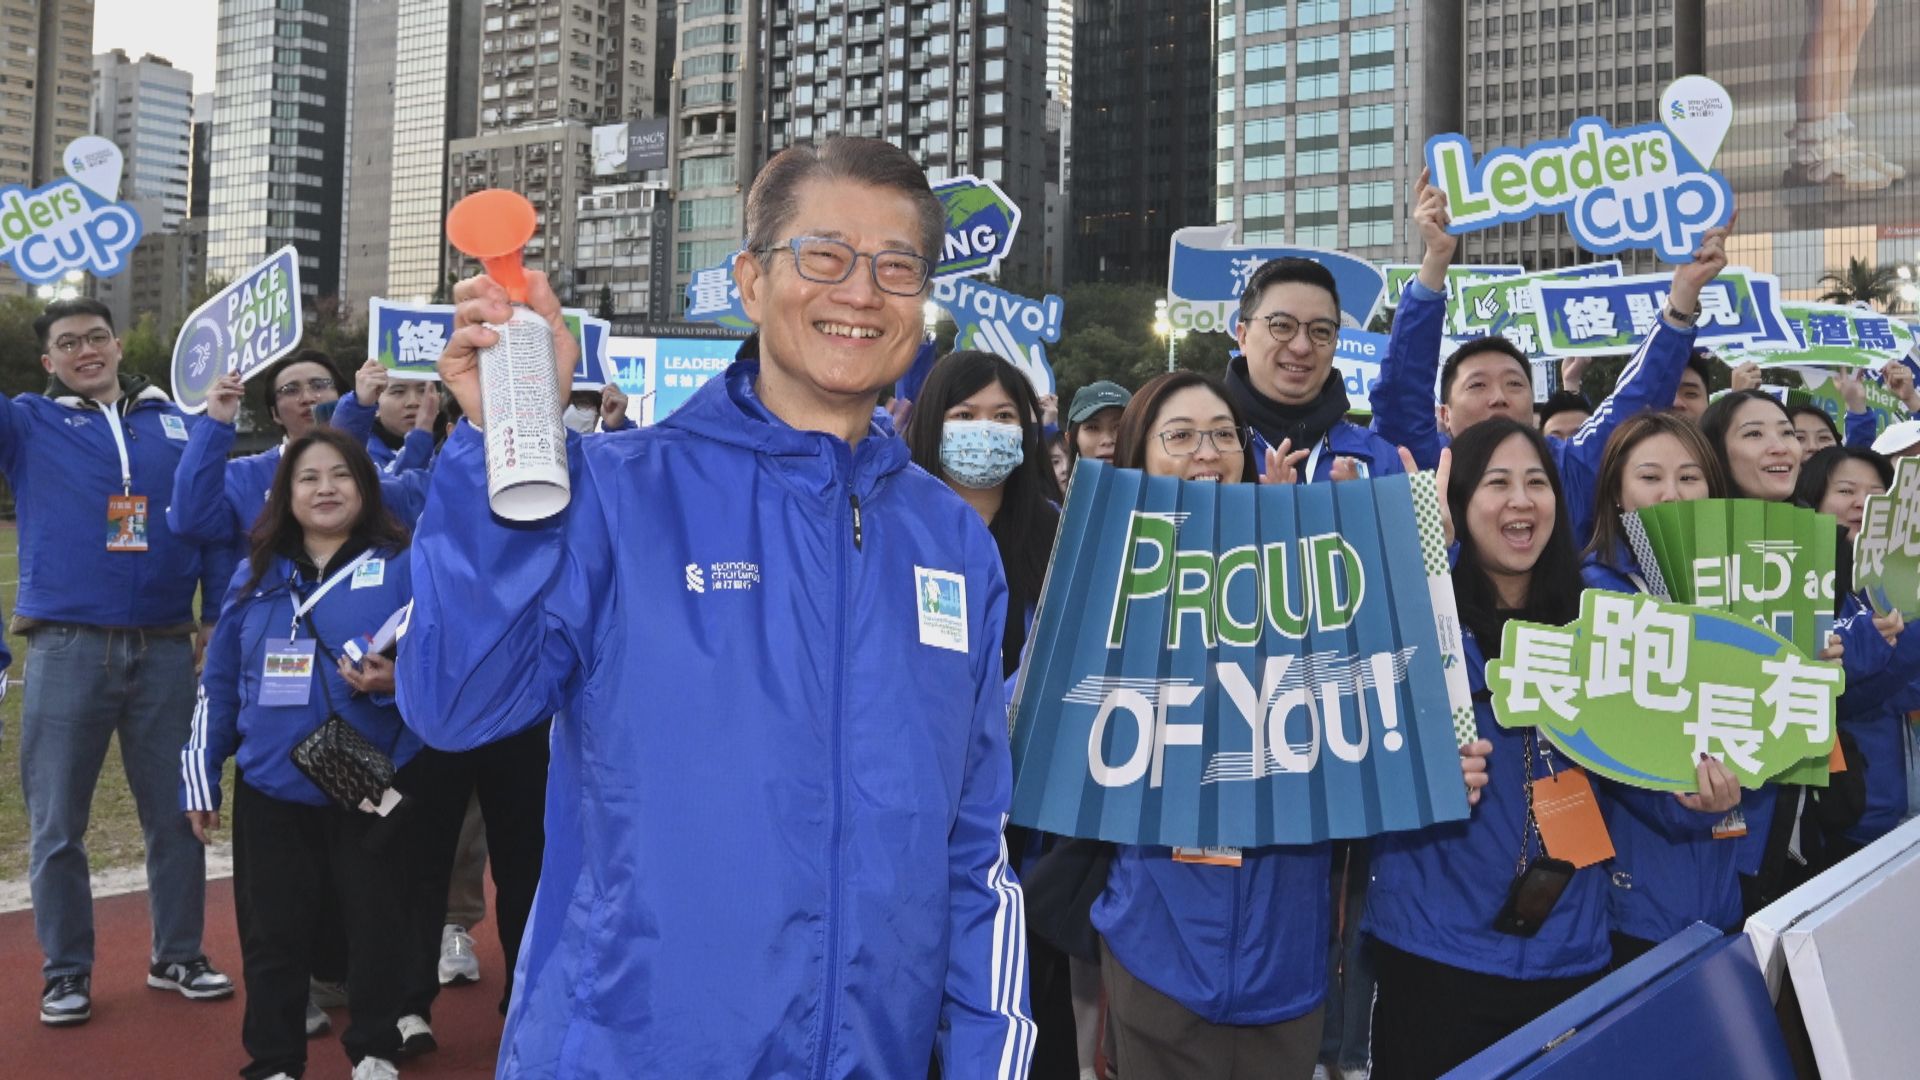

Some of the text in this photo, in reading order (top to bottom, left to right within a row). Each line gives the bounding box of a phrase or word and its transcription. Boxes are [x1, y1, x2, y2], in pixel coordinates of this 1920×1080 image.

[1441, 133, 1668, 218] Leaders
[0, 187, 81, 250] ders
[227, 289, 288, 350] YOUR
[228, 262, 280, 322] PACE
[934, 279, 1058, 338] Bravo!
[1168, 302, 1225, 330] Go!
[227, 322, 281, 374] PACE
[1106, 511, 1365, 649] PROUD
[1088, 684, 1204, 788] OF
